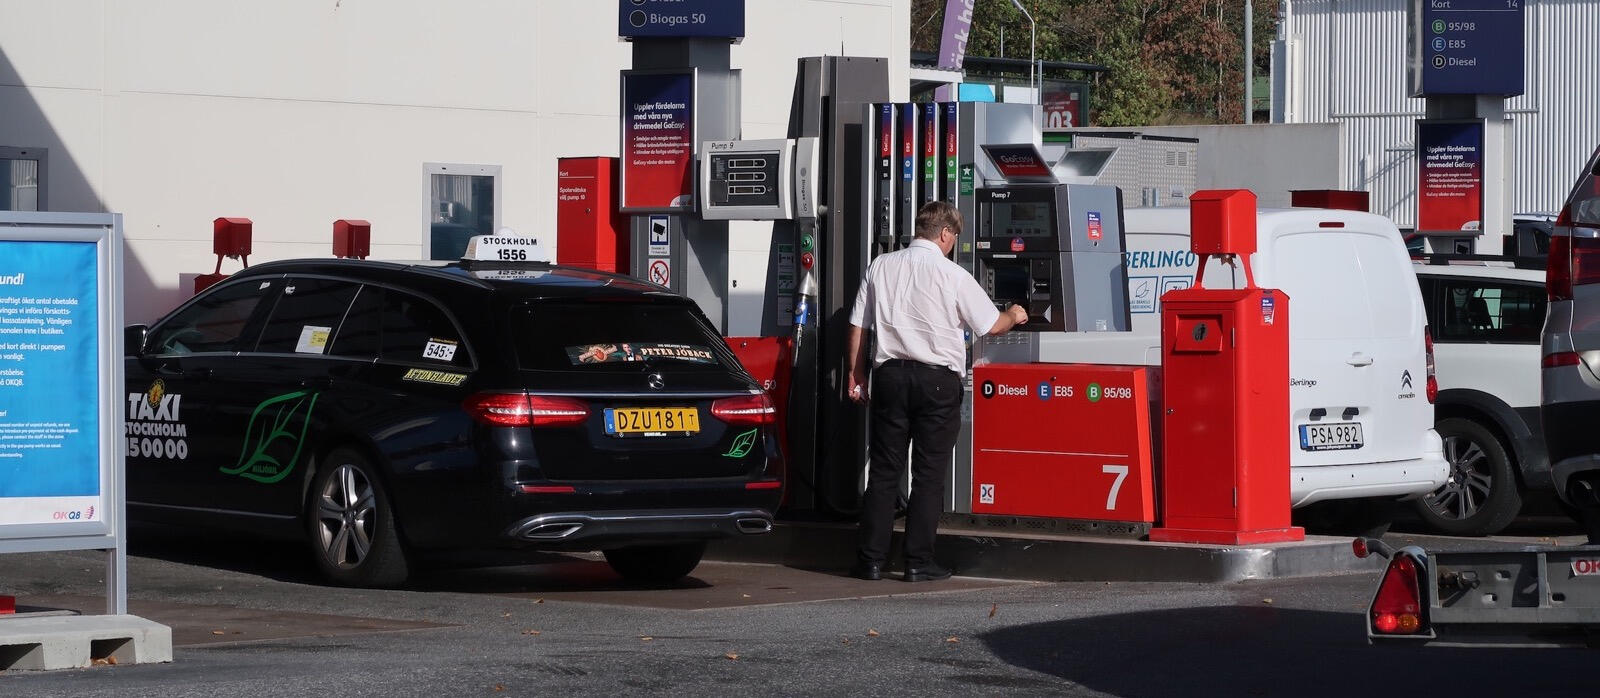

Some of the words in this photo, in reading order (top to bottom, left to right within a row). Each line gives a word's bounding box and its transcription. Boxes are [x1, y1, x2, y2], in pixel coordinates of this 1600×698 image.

[1431, 0, 1450, 9] Kort
[1507, 0, 1518, 9] 14
[650, 13, 689, 26] Biogas
[691, 13, 706, 24] 50
[1435, 23, 1443, 31] B
[1448, 22, 1476, 31] 95/98
[1435, 40, 1442, 49] E
[1448, 40, 1466, 49] E85
[1435, 57, 1443, 66] D
[1448, 57, 1477, 66] Diesel
[634, 103, 655, 112] Upplev
[655, 101, 685, 110] fördelarna
[633, 112, 647, 120] med
[648, 111, 661, 120] våra
[661, 113, 673, 121] nya
[633, 122, 663, 130] drivmedel
[729, 141, 735, 149] 9
[1426, 145, 1447, 154] Upplev
[991, 191, 1006, 199] Pump
[483, 237, 538, 246] STOCKHOLM
[497, 248, 527, 261] 1556
[1126, 250, 1196, 269] BERLINGO
[40, 344, 66, 352] pumpen
[426, 343, 454, 358] 545:-
[641, 348, 673, 357] PETER
[675, 347, 713, 360] JÖBACK
[763, 379, 777, 391] 50
[1290, 378, 1318, 388] Berlingo
[984, 384, 993, 395] D
[998, 383, 1029, 396] Diesel
[1040, 385, 1048, 397] E
[1054, 386, 1074, 397] E85
[1090, 387, 1099, 398] B
[1103, 387, 1133, 399] 95/98
[128, 392, 182, 421] TAXI
[617, 410, 685, 430] DZU181
[1311, 426, 1334, 444] PSA
[1336, 426, 1359, 443] 982
[1102, 464, 1129, 511] 7
[53, 511, 81, 520] OKQ8
[1575, 559, 1600, 574] OK
